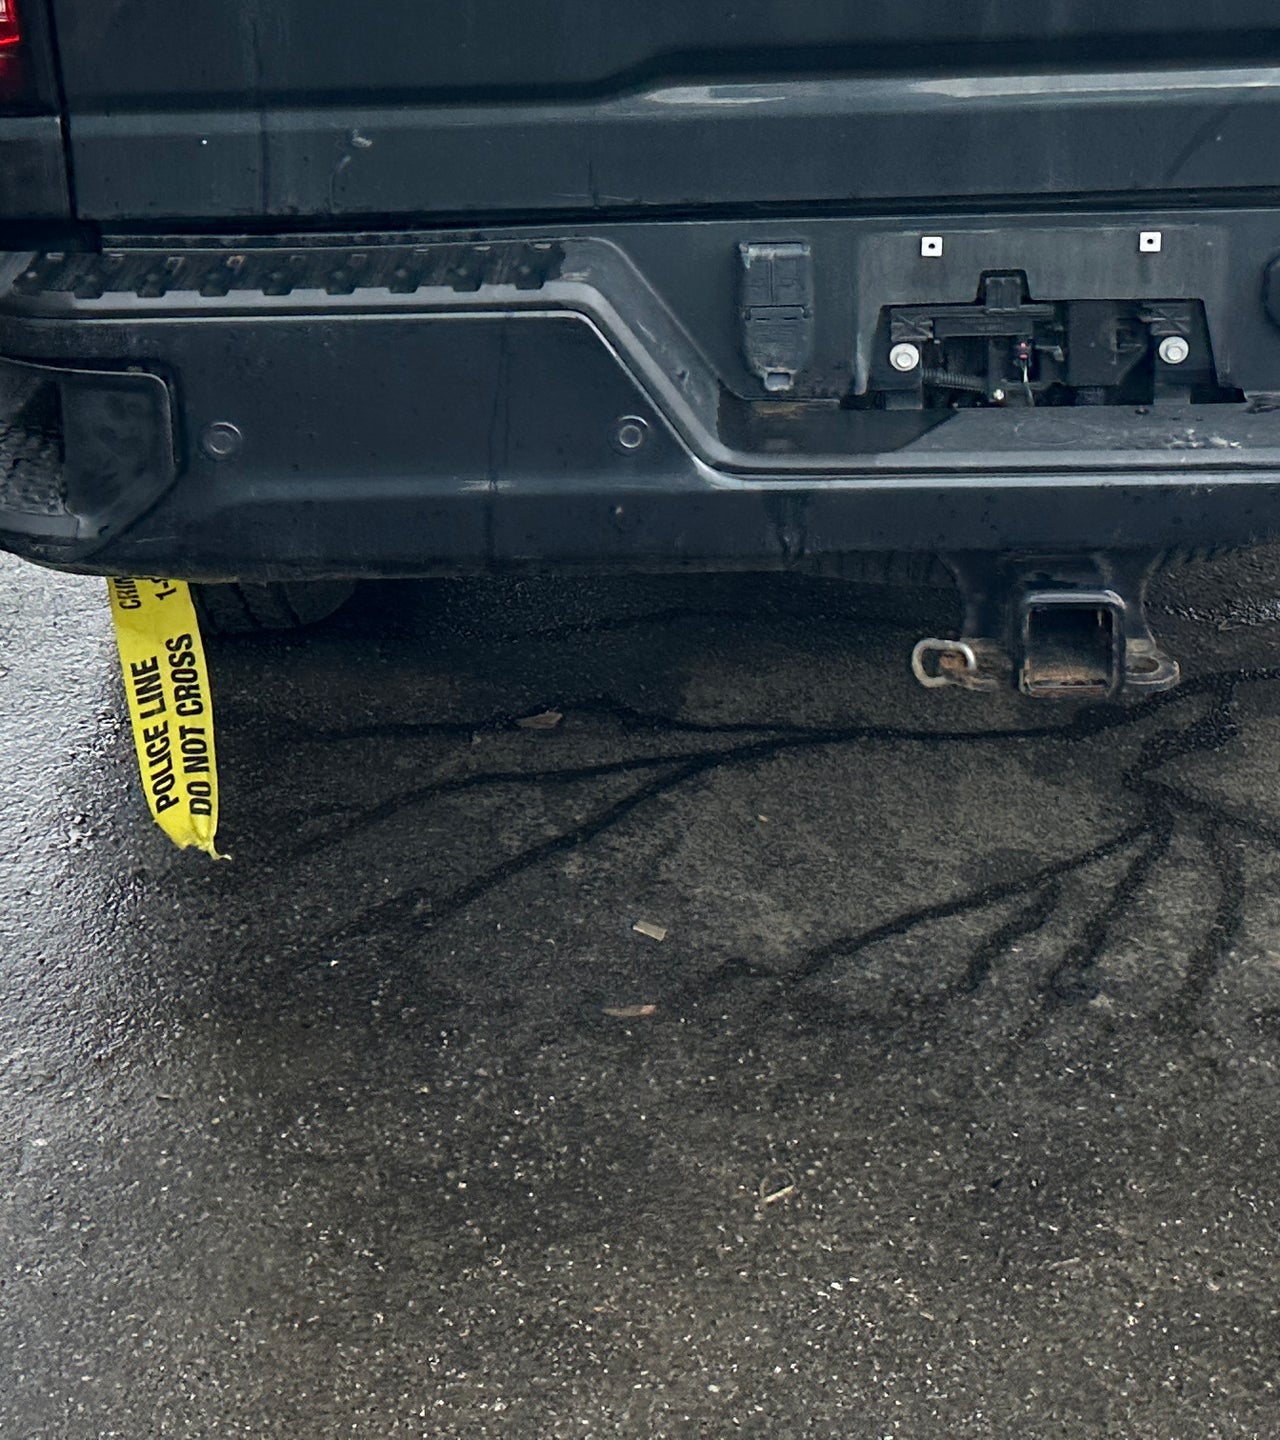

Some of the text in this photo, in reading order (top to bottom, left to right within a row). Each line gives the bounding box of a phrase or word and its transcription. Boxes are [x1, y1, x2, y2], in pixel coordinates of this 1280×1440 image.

[130, 656, 179, 814] POLICE LINE
[165, 633, 212, 816] DO NOT CROSS
